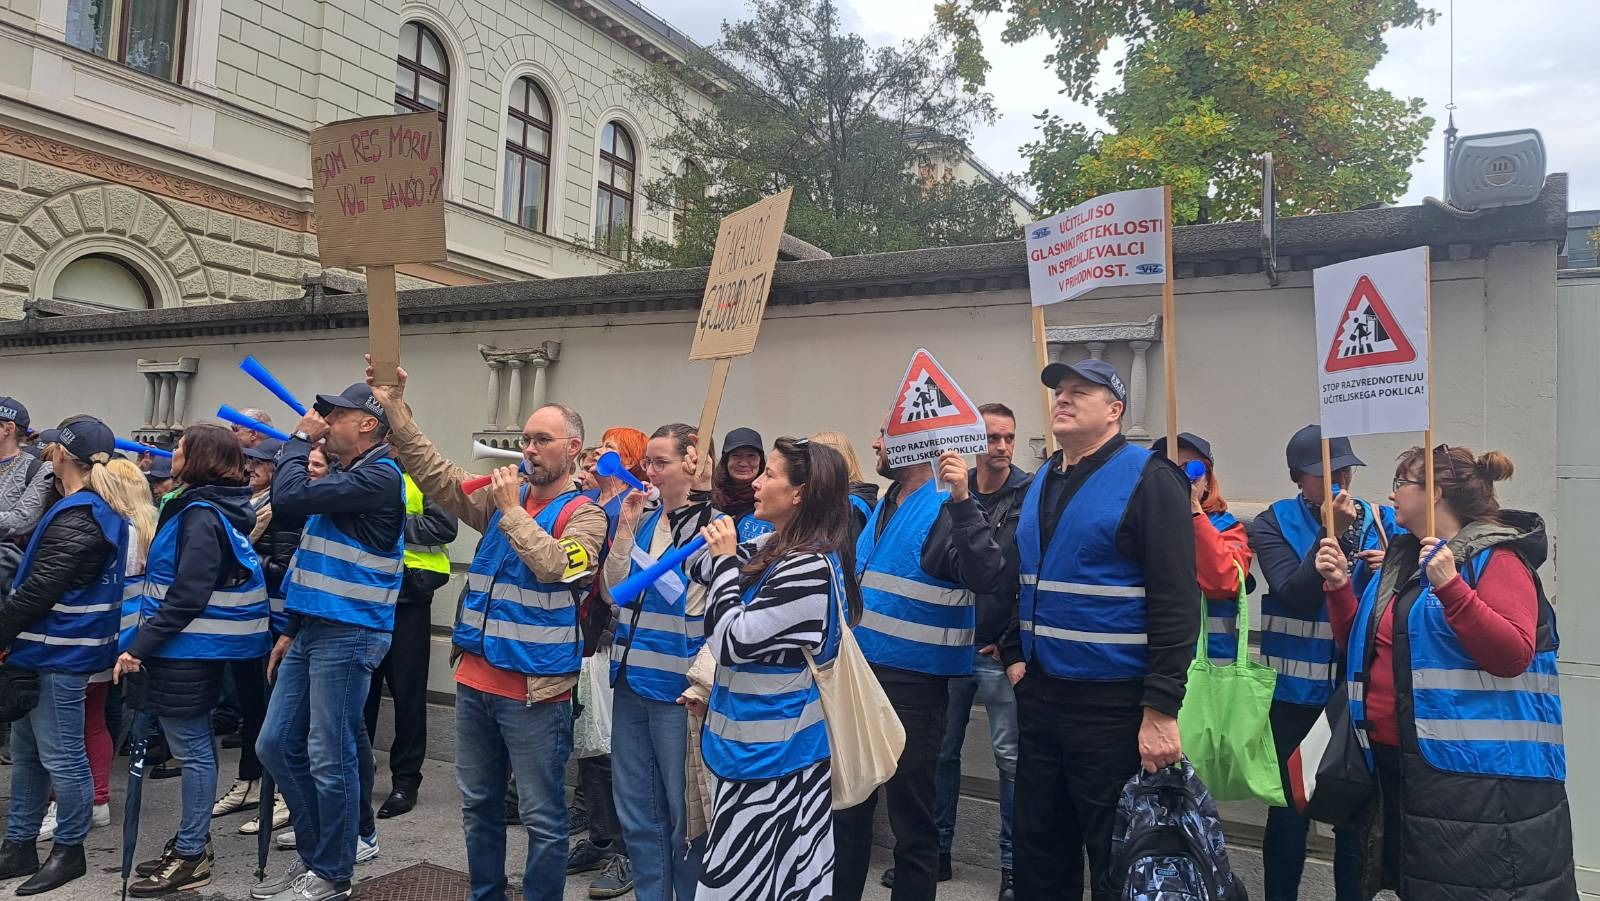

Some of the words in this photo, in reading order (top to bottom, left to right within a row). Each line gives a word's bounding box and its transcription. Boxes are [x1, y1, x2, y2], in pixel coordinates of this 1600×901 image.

[1059, 208, 1094, 234] UČITELJI
[1095, 203, 1115, 218] SO
[1031, 237, 1076, 261] GLASNIKI
[1076, 219, 1162, 244] PRETEKLOSTI
[1048, 264, 1058, 277] IN
[1058, 281, 1065, 292] V
[1323, 383, 1339, 393] STOP
[1342, 373, 1424, 389] RAZVREDNOTENJU
[1323, 390, 1376, 404] UČITELJSKEGA
[1379, 386, 1424, 397] POKLICA!
[887, 445, 906, 455] STOP
[909, 433, 986, 451] RAZVREDNOTENJU
